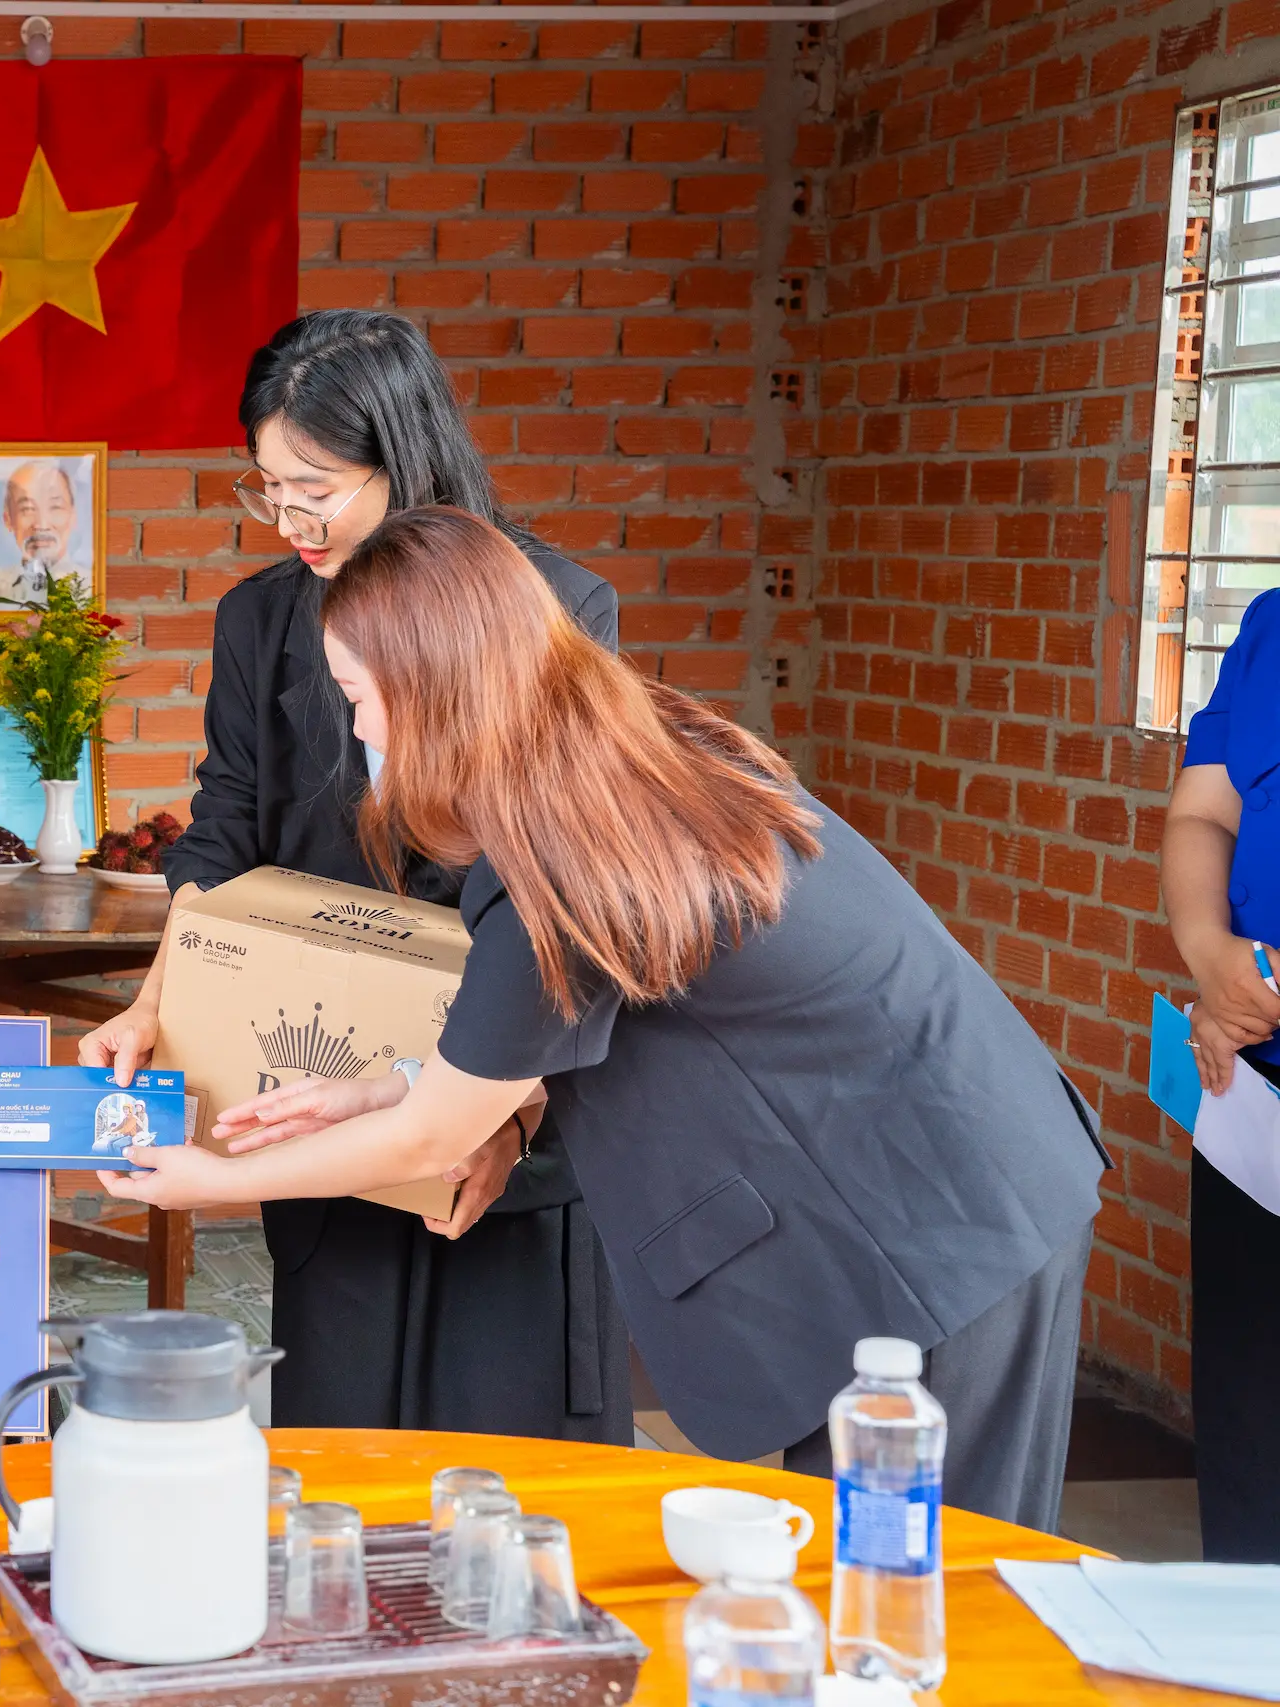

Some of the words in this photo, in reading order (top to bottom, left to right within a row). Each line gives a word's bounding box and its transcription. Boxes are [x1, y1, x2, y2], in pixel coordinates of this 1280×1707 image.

[309, 910, 413, 940] Royal
[248, 913, 434, 961] www.achau-group.com
[203, 948, 231, 960] GROUP
[205, 939, 213, 948] A
[215, 942, 247, 956] CHAU
[157, 1078, 174, 1086] ROC
